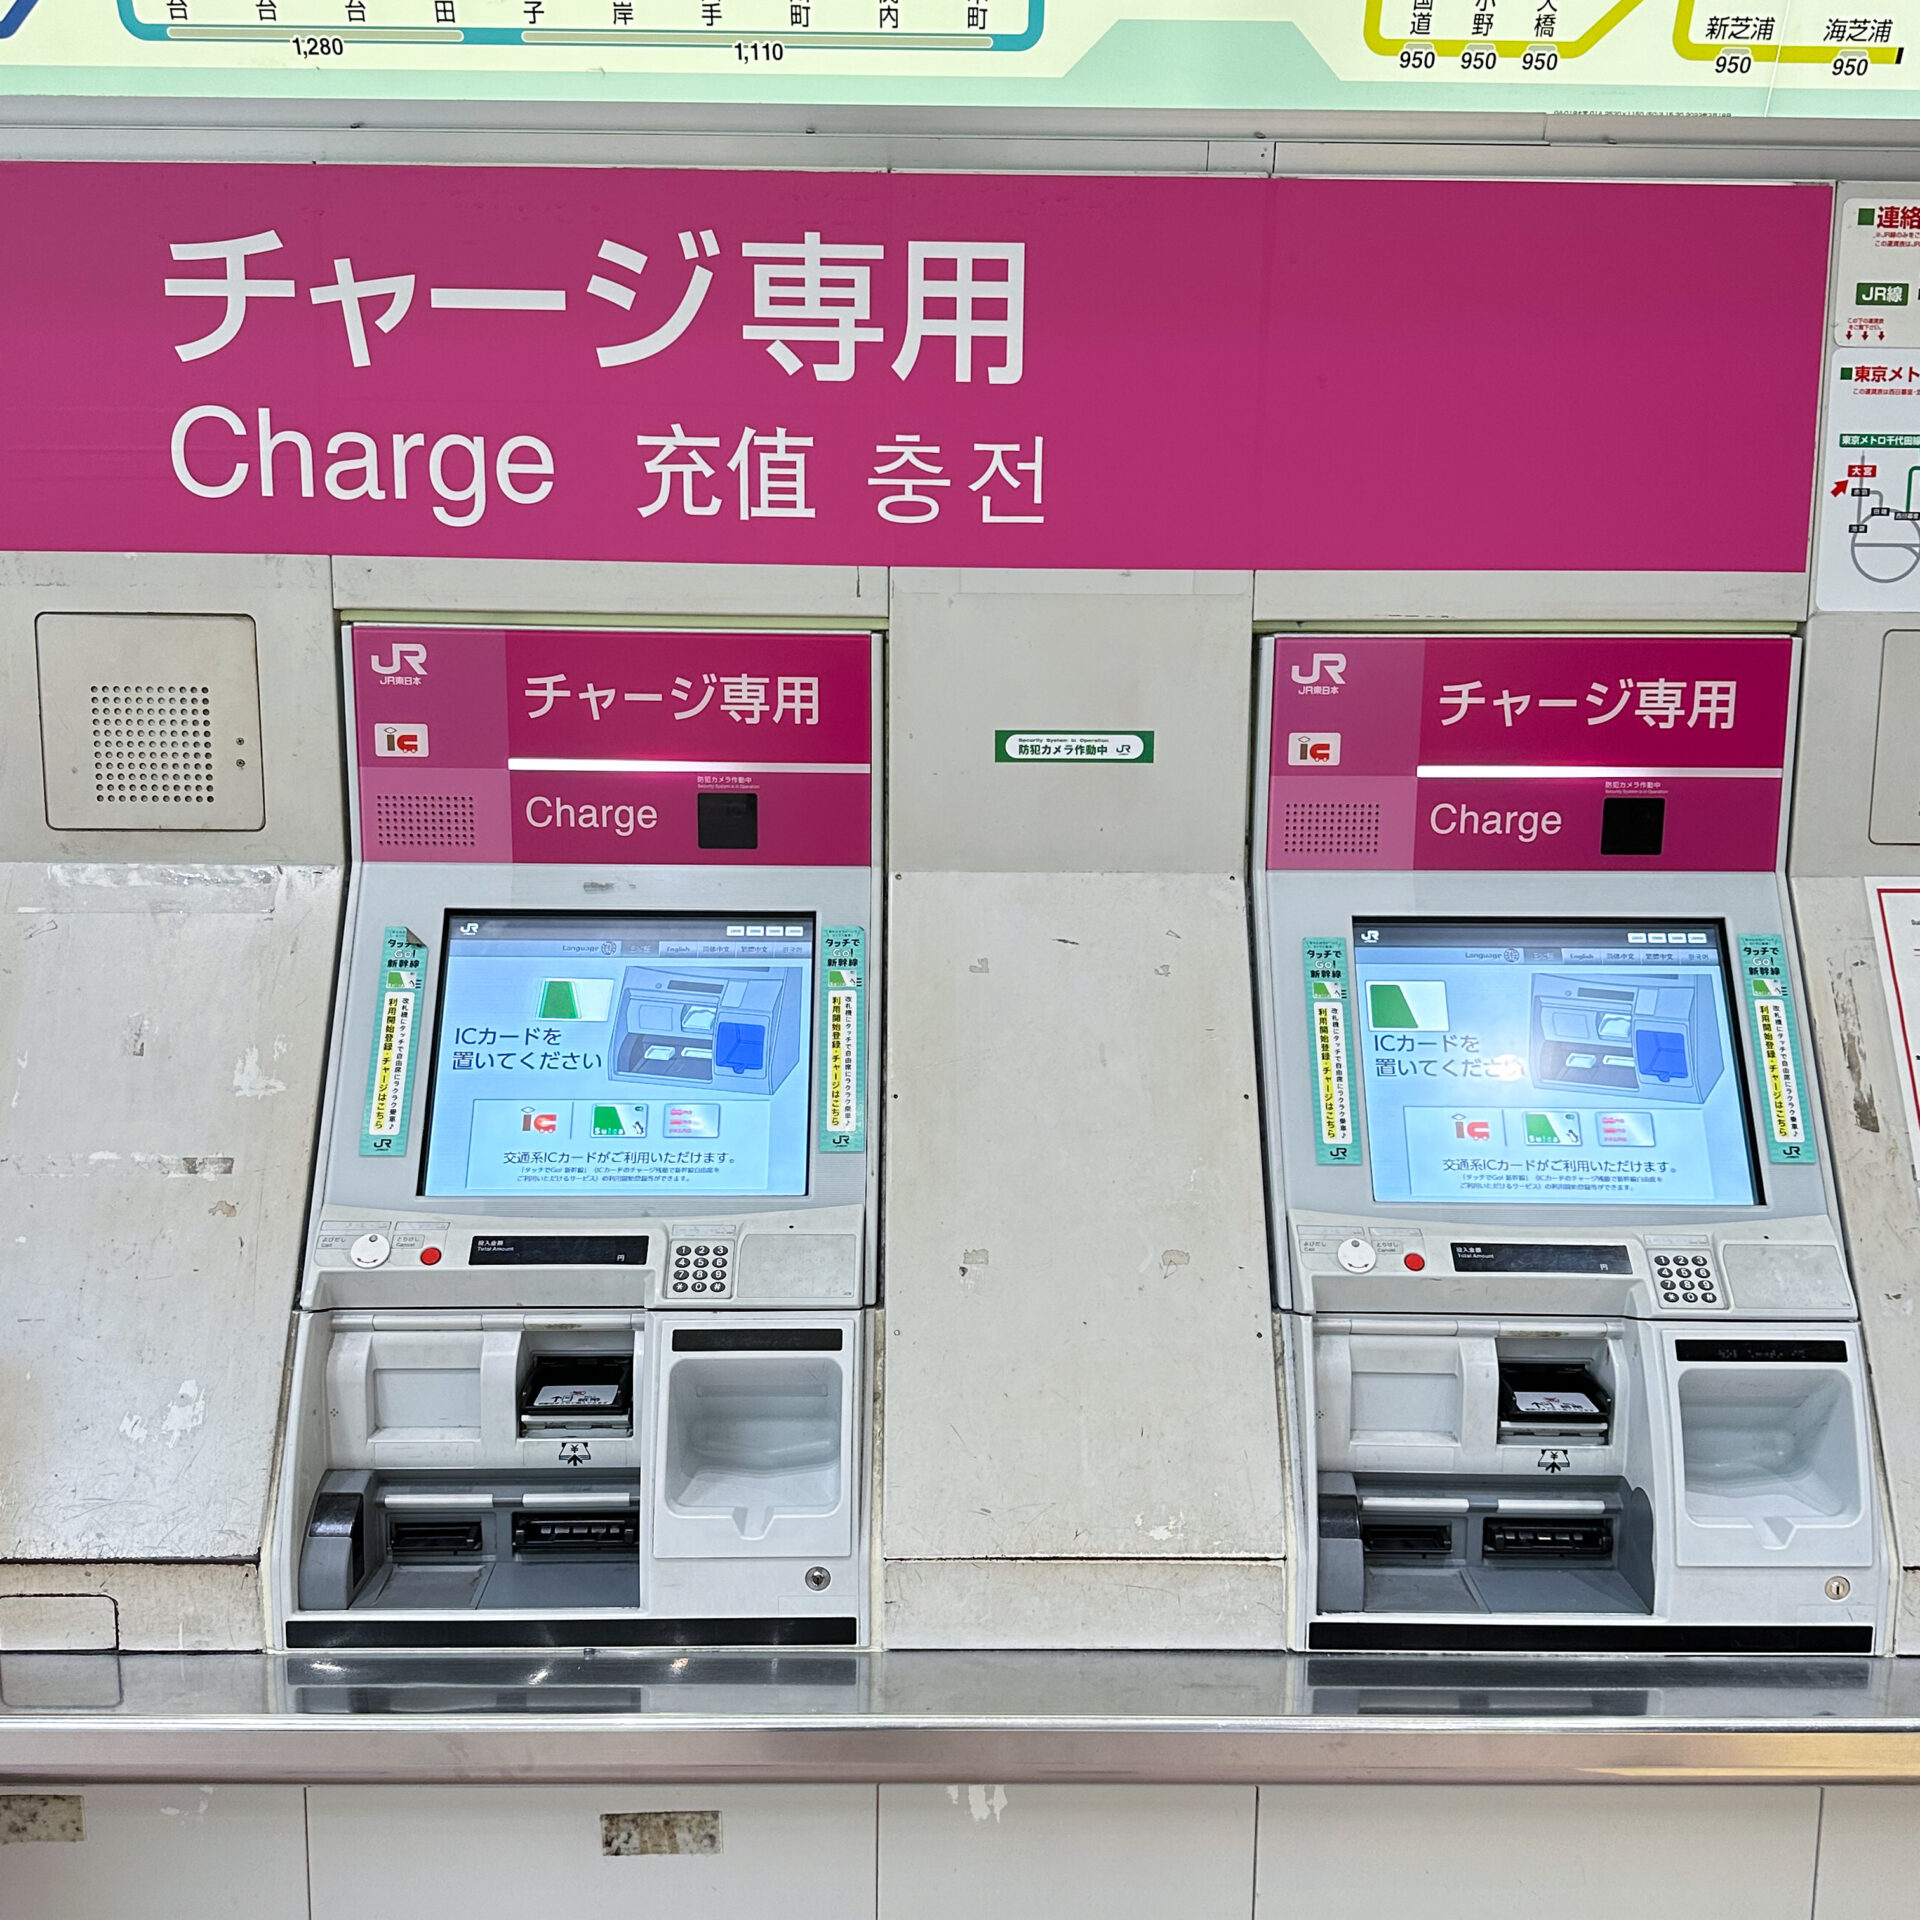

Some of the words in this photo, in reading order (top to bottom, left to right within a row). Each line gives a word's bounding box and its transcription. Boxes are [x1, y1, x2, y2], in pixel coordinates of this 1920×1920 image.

[434, 0, 456, 23] 田
[1705, 16, 1775, 41] 新芝浦
[1823, 18, 1893, 43] 海芝浦
[292, 37, 344, 59] 1,280
[734, 43, 784, 63] 1,110
[1399, 51, 1436, 69] 950
[1460, 52, 1497, 70] 950
[1521, 53, 1558, 71] 950
[1715, 56, 1752, 74] 950
[1831, 58, 1869, 76] 950
[1877, 206, 1920, 229] 連絡
[1862, 286, 1903, 302] JR線
[164, 229, 1025, 386] チャージ専用
[1854, 365, 1920, 383] 東京メト
[170, 404, 555, 528] Charge
[636, 423, 816, 520] 充值
[1851, 467, 1873, 476] 大宮
[371, 643, 428, 675] JR
[1291, 653, 1346, 685] JR
[380, 676, 422, 686] JR東日本
[524, 673, 819, 725] チャージ専用
[1298, 686, 1339, 695] JR東日本
[1439, 678, 1737, 730] チャージ専用
[1018, 744, 1108, 755] 防犯カメラ作動中
[526, 796, 658, 836] Charge
[1430, 803, 1562, 842] Charge
[826, 938, 860, 947] タッチで
[1743, 946, 1780, 956] タッチで
[394, 949, 416, 958] Go!
[832, 948, 853, 957] Go!
[1306, 950, 1342, 959] タッチで
[1752, 957, 1774, 966] Go!
[387, 959, 420, 968] 新幹線
[827, 958, 858, 967] 新幹線
[1315, 960, 1336, 969] Go!
[1748, 967, 1780, 976] 新幹線
[1310, 969, 1341, 978] 新幹線
[455, 1027, 562, 1045] ICカードを
[1374, 1034, 1480, 1053] ICカードを
[452, 1051, 601, 1070] 置いてください
[374, 1139, 392, 1149] JR
[833, 1136, 849, 1145] JR
[503, 1151, 736, 1164] 交通系ICカードがご利用いただけます。
[1330, 1147, 1347, 1157] JR
[1783, 1146, 1801, 1155] JR
[1442, 1159, 1677, 1172] 交通系ICカードがご利用いただけます。
[617, 1254, 625, 1262] 円
